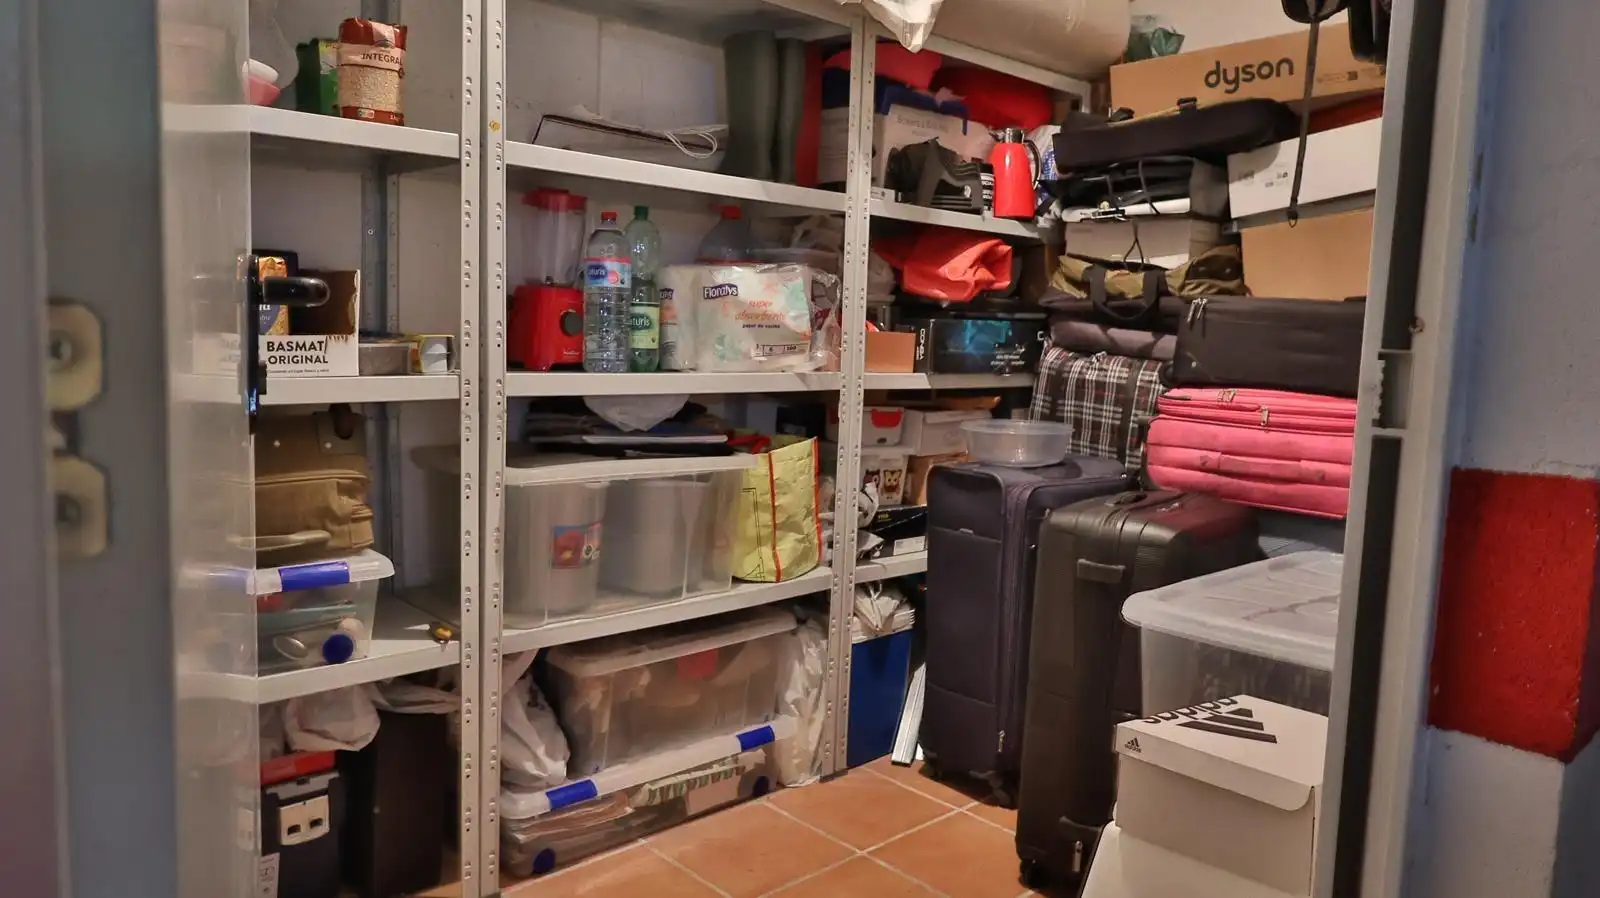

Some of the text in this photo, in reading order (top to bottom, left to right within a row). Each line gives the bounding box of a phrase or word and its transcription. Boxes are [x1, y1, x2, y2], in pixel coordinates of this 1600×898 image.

[361, 53, 403, 65] INTEGRAL
[1204, 57, 1294, 94] dyson
[704, 285, 738, 298] Floralys
[268, 355, 329, 365] ORIGINAL
